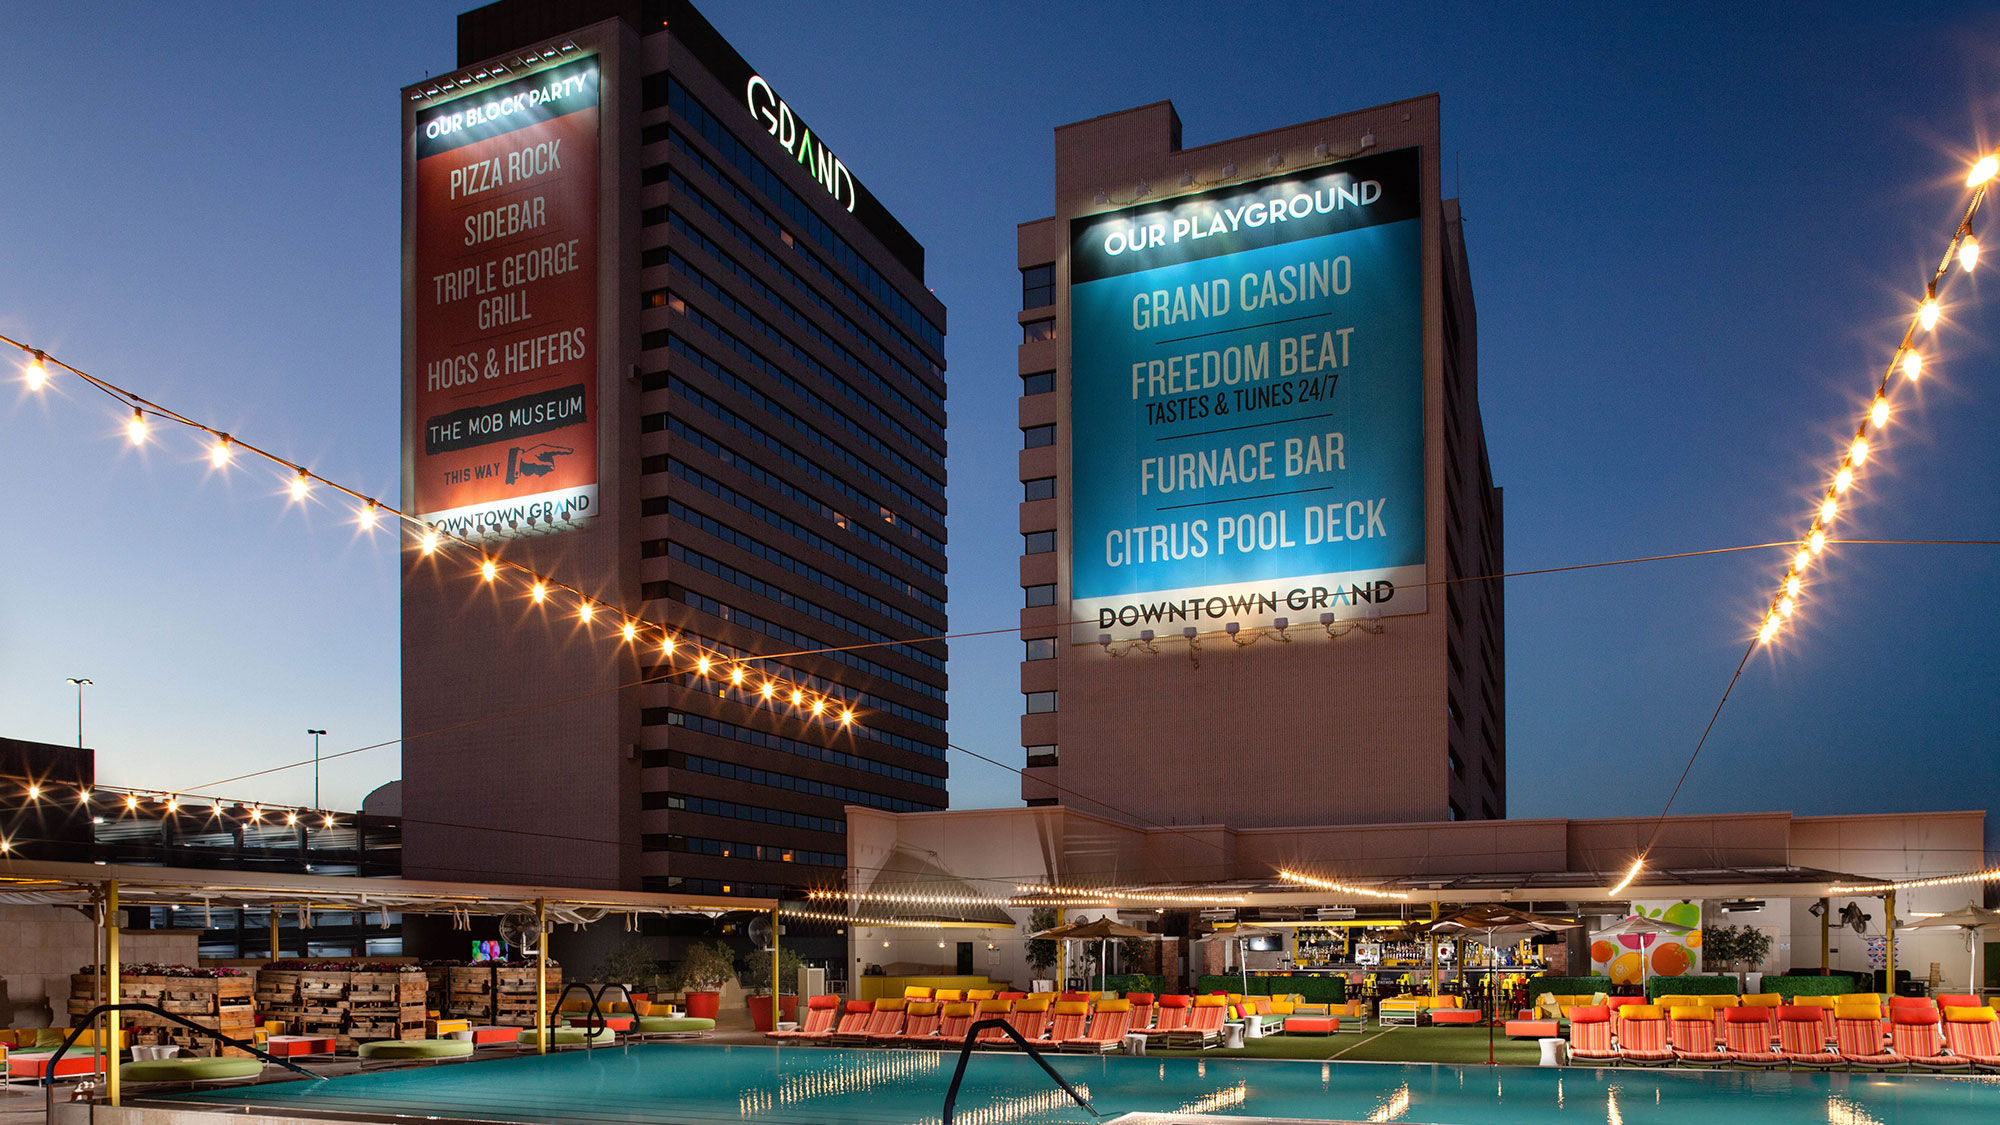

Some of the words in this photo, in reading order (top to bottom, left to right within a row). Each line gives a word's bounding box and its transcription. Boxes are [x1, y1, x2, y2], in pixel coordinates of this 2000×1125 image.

[426, 114, 462, 139] OUR
[466, 93, 525, 127] BLOCK
[530, 73, 587, 107] PARTY
[450, 157, 503, 200] PIZZA
[508, 138, 561, 184] ROCK
[747, 75, 855, 213] GRAND
[464, 196, 546, 246] SIDEBAR
[1103, 221, 1166, 257] OUR
[1173, 180, 1382, 244] PLAYGROUND
[433, 261, 497, 305] TRIPLE
[502, 239, 579, 288] GEORGE
[1132, 278, 1230, 330] GRAND
[1240, 255, 1351, 311] CASINO
[478, 290, 532, 330] GRILL
[428, 352, 479, 392] HOGS
[483, 348, 500, 379] &
[505, 327, 586, 375] HEIFERS
[1131, 341, 1269, 400] FREEDOM
[1280, 327, 1355, 377] BEAT
[429, 421, 462, 444] THE
[468, 412, 504, 436] MOB
[509, 395, 582, 428] MUSEUM
[1145, 395, 1209, 426] TASTES
[1214, 392, 1229, 416] &
[1233, 381, 1293, 412] TUNES
[1298, 374, 1339, 403] 24/7
[444, 468, 471, 486] THIS
[474, 462, 501, 480] WAY
[1141, 441, 1275, 496] FURNACE
[1285, 432, 1346, 477] BAR
[530, 494, 590, 520] GRAND
[1105, 519, 1208, 568] CITRUS
[1218, 509, 1296, 555] POOL
[1304, 498, 1387, 545] DECK
[1099, 590, 1277, 630] DOWNTOWN
[1286, 579, 1395, 611] GRAND
